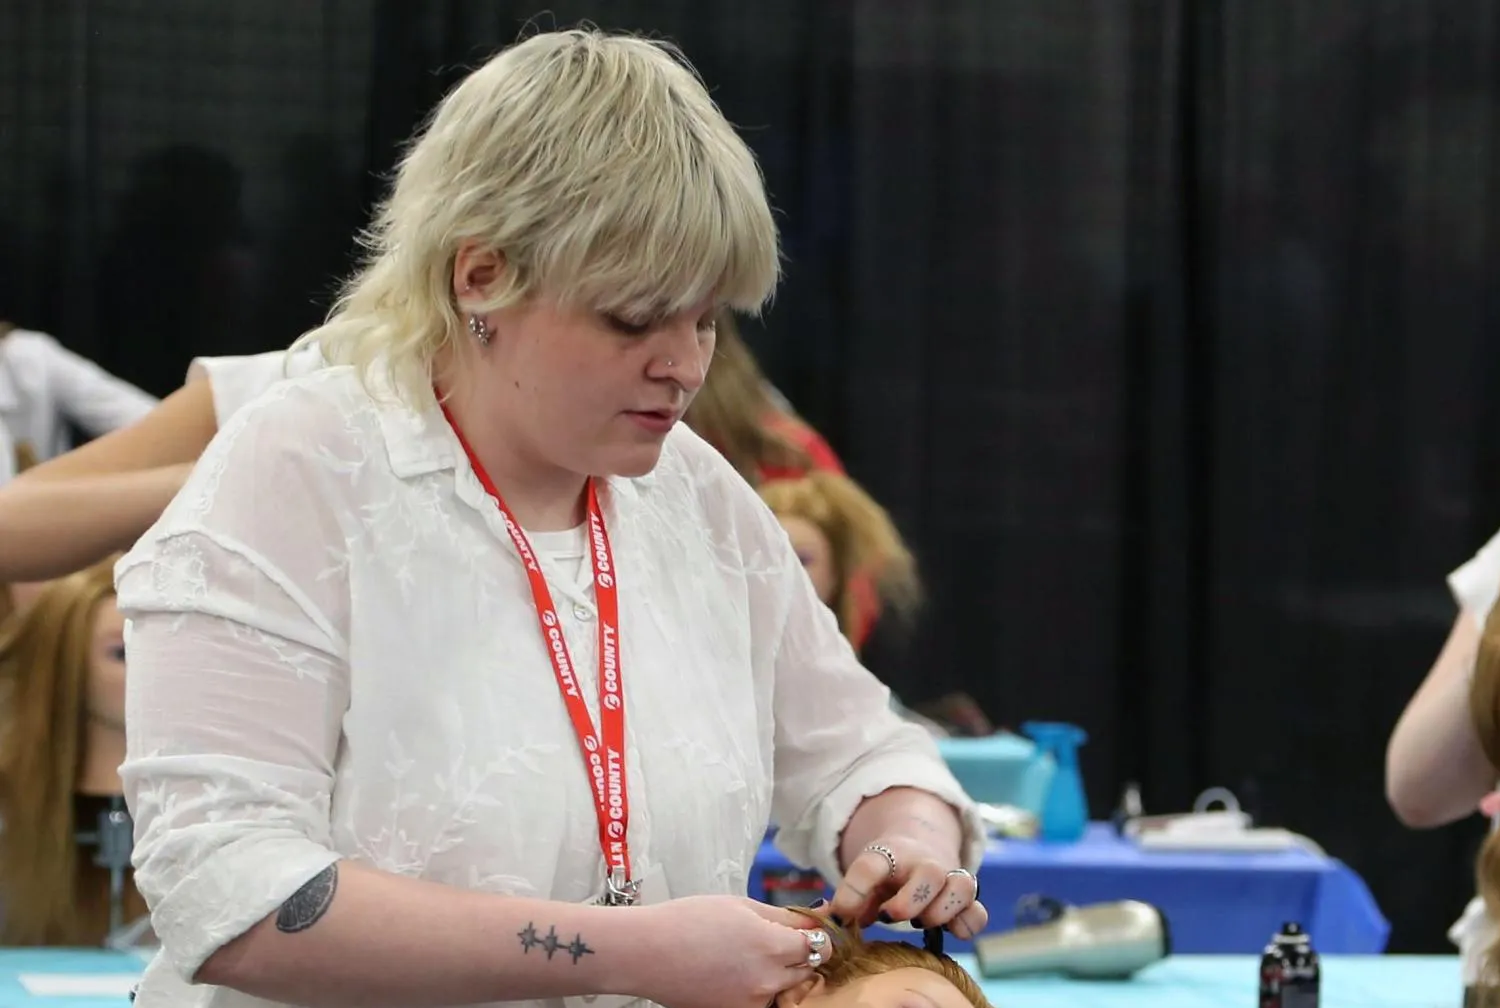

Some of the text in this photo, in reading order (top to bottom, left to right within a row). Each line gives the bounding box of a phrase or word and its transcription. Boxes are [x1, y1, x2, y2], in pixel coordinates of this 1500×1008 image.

[591, 511, 610, 572] COUNTY
[549, 628, 579, 699] COUNTY
[603, 621, 617, 693] COUNTY
[607, 746, 623, 819] COUNTY
